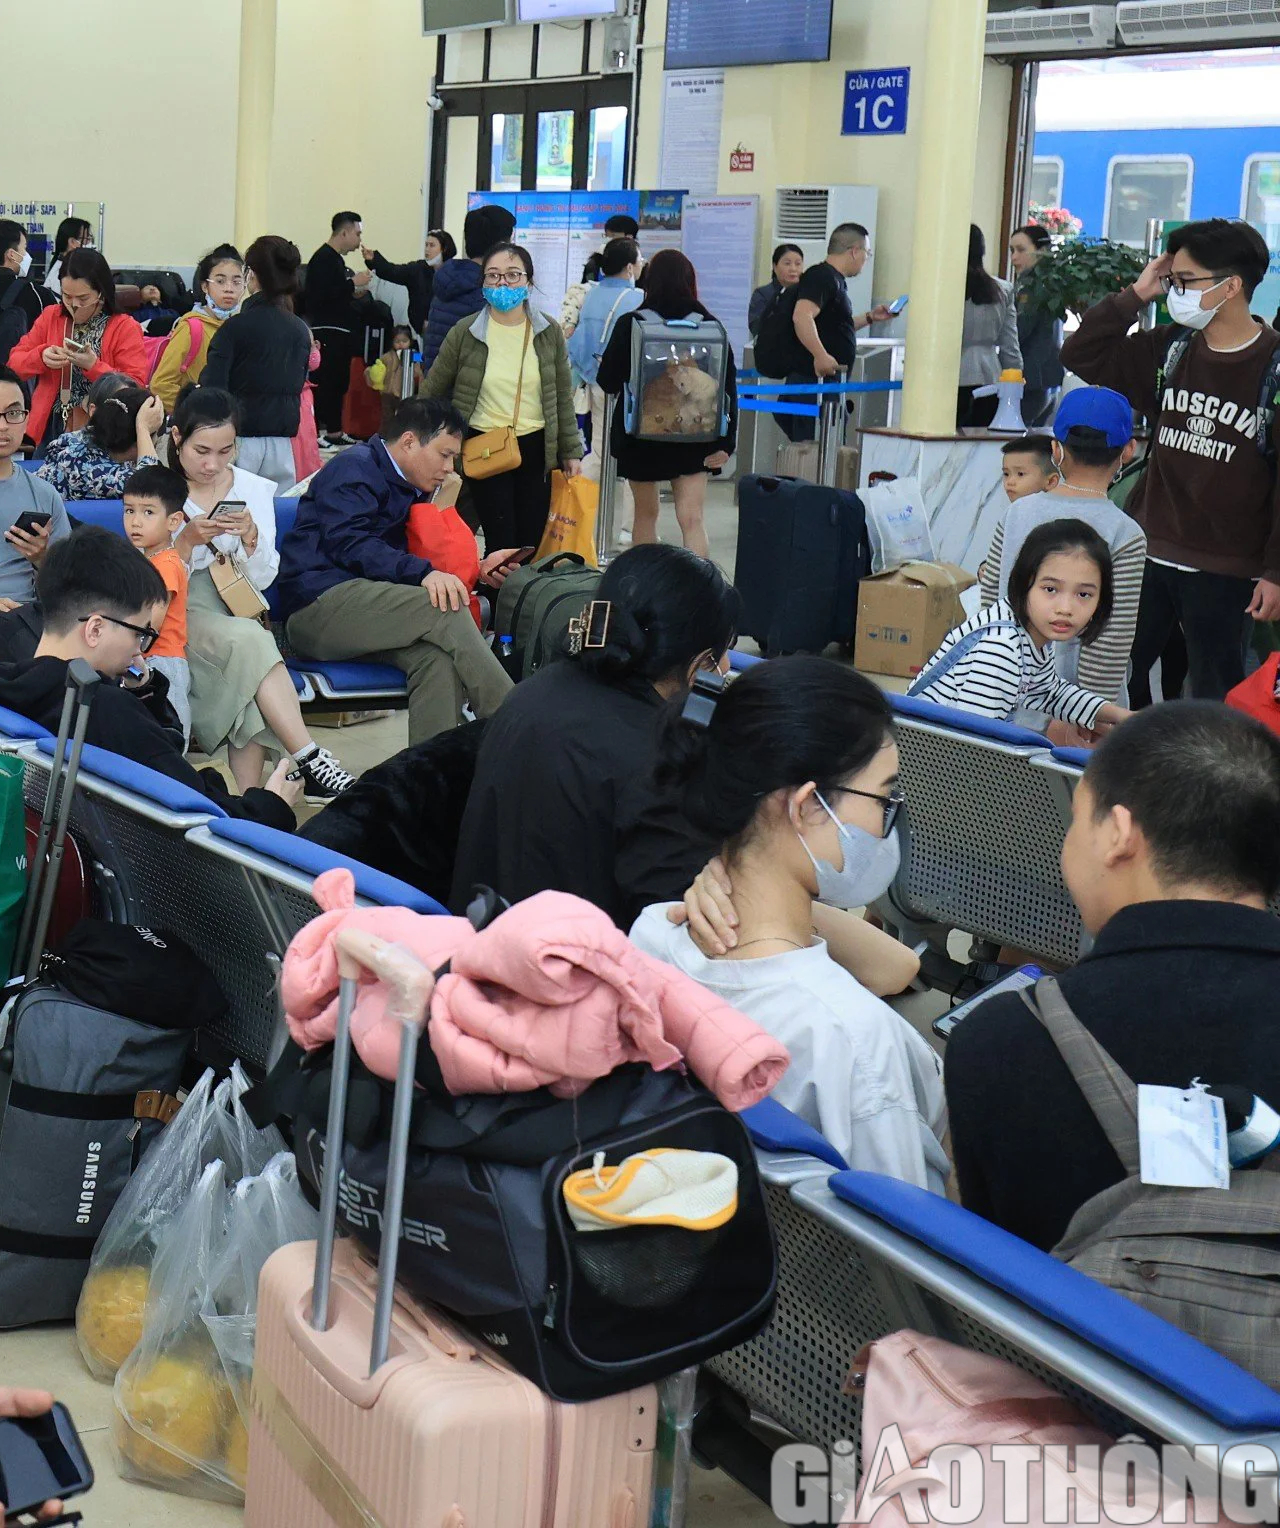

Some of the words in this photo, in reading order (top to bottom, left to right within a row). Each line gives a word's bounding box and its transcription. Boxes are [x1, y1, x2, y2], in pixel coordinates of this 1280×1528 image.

[848, 74, 869, 90] CỬA
[877, 76, 904, 89] GATE
[855, 94, 894, 130] 1C
[40, 204, 57, 216] SAPA
[1189, 418, 1212, 435] MU
[1158, 425, 1237, 464] UNIVERSITY
[75, 1141, 102, 1224] SAMSUNG
